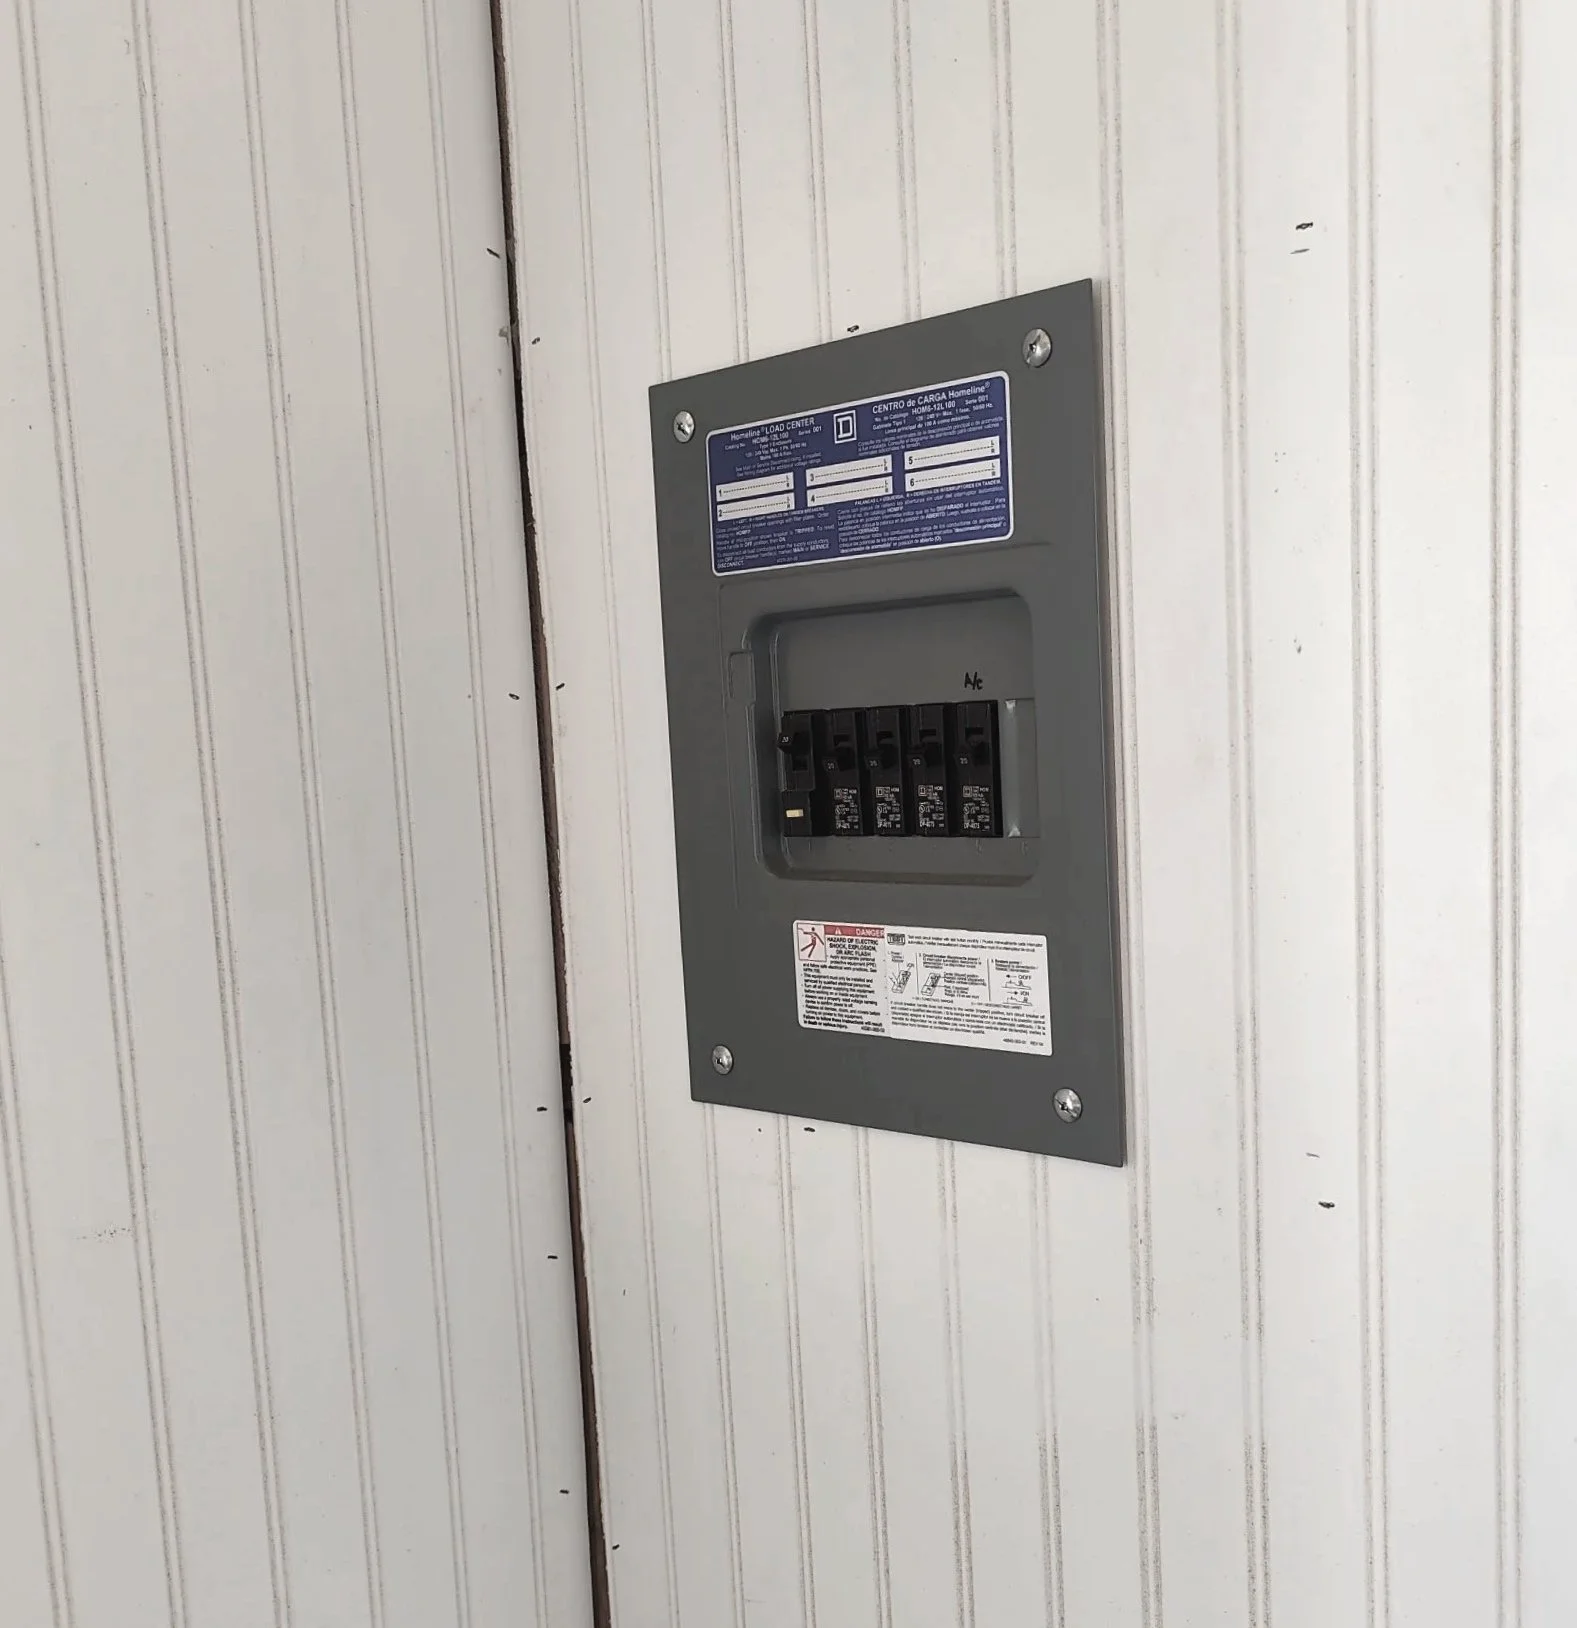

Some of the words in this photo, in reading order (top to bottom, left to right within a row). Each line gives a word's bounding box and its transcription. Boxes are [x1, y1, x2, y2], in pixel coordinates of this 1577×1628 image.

[977, 392, 988, 402] 001
[872, 399, 904, 414] CENTRO
[906, 396, 916, 407] de
[917, 390, 946, 405] CARGA
[765, 422, 784, 434] LOAD
[786, 416, 814, 430] CENTER
[812, 425, 822, 434] 001
[908, 455, 913, 465] 5
[809, 473, 814, 482] 3
[909, 478, 914, 487] 6
[810, 494, 815, 503] 4
[718, 508, 722, 517] 2
